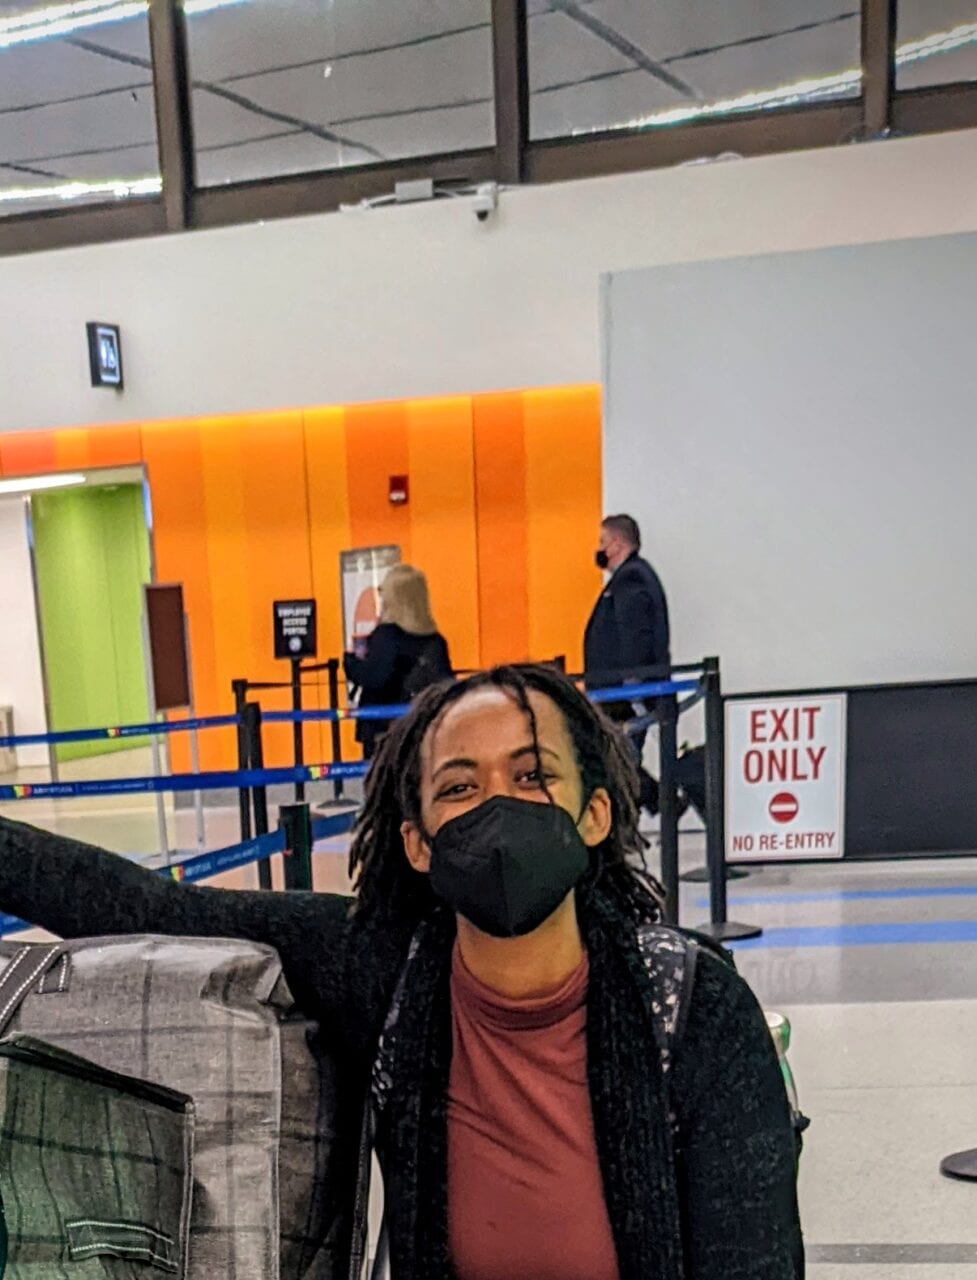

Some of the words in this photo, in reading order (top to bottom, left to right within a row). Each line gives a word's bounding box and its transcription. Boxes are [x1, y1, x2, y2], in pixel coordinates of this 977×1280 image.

[750, 706, 821, 743] EXIT
[743, 746, 827, 783] ONLY
[732, 835, 754, 851] NO
[759, 831, 836, 851] RE-ENTRY
